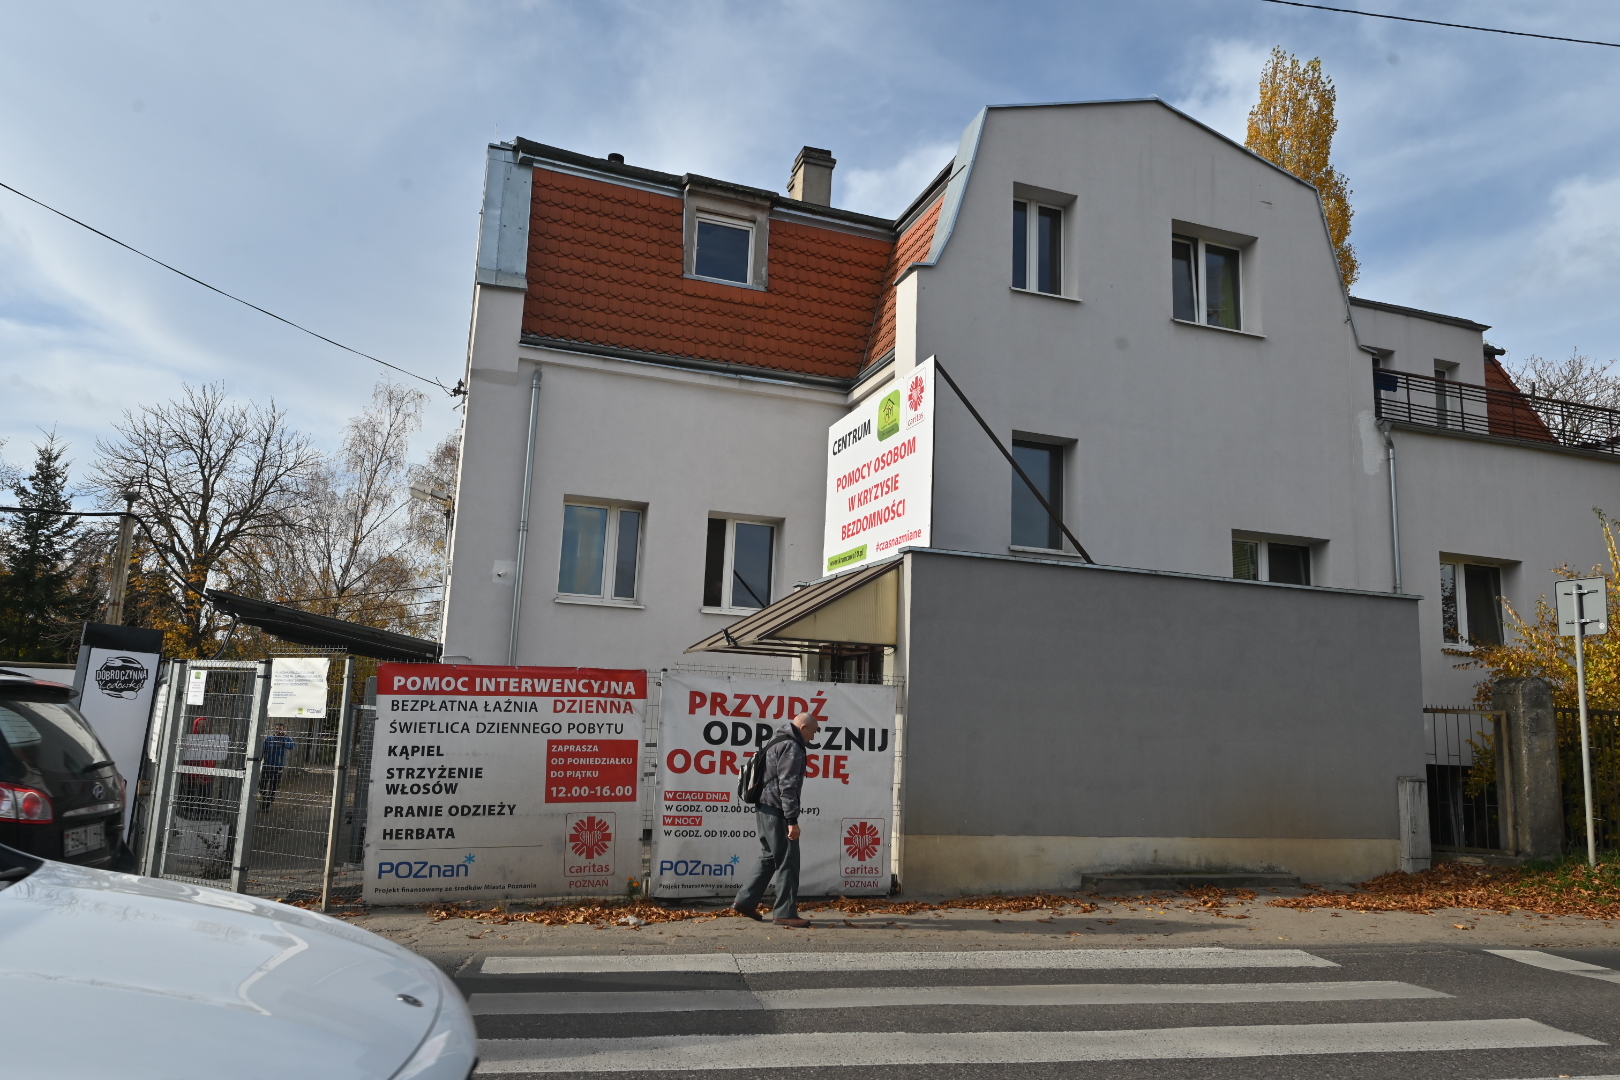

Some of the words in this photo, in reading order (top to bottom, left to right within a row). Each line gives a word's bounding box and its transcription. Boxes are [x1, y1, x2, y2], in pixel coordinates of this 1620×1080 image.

[908, 412, 923, 426] caritas
[832, 418, 871, 456] CENTRUM
[836, 460, 872, 493] POMOCY
[874, 436, 917, 473] OSOBOM
[848, 496, 856, 512] W
[857, 473, 899, 509] KRYZYSIE
[841, 499, 906, 541] BEZDOMNOŚCI
[97, 670, 147, 680] DOBROCZYNNA
[393, 676, 469, 691] POMOC
[475, 677, 636, 695] INTERWENCYJNA
[391, 699, 478, 712] BEZPŁATNA
[484, 699, 538, 713] ŁAŹNIA
[553, 699, 634, 714] DZIENNA
[688, 690, 829, 722] PRZYJDŹ
[389, 720, 470, 734] ŚWIETLICA
[476, 722, 562, 734] DZIENNEGO
[567, 722, 624, 734] POBYTU
[703, 720, 888, 752] ODPCZNIJ
[388, 745, 444, 760] KĄPIEL
[551, 744, 599, 752] ZAPRASZA
[567, 757, 633, 765] PONIEDZIAŁKU
[386, 765, 483, 779] STRZYŻENIE
[567, 770, 599, 779] PIĄTKU
[805, 754, 850, 784] SIĘ
[385, 781, 458, 795] WŁOSÓW
[550, 786, 633, 797] 12.00-16.00
[665, 792, 675, 800] W
[677, 792, 704, 802] CIĄGU
[706, 792, 728, 801] DNIA
[384, 805, 443, 817] PRANIE
[448, 801, 517, 817] ODZIEŻY
[665, 805, 675, 813] W
[676, 804, 703, 813] GODZ.
[705, 805, 718, 813] OD
[721, 805, 742, 814] 12.00
[743, 806, 756, 814] DO
[664, 816, 673, 824] W
[675, 817, 701, 825] NOCY
[382, 827, 455, 840] HERBATA
[675, 829, 702, 838] GODZ.
[704, 830, 718, 838] OD
[720, 830, 741, 838] 19.00
[742, 830, 756, 838] DO
[569, 862, 610, 873] caritas
[845, 865, 879, 874] caritas
[569, 877, 609, 888] POZNAŃ
[844, 879, 878, 888] POZNAŃ
